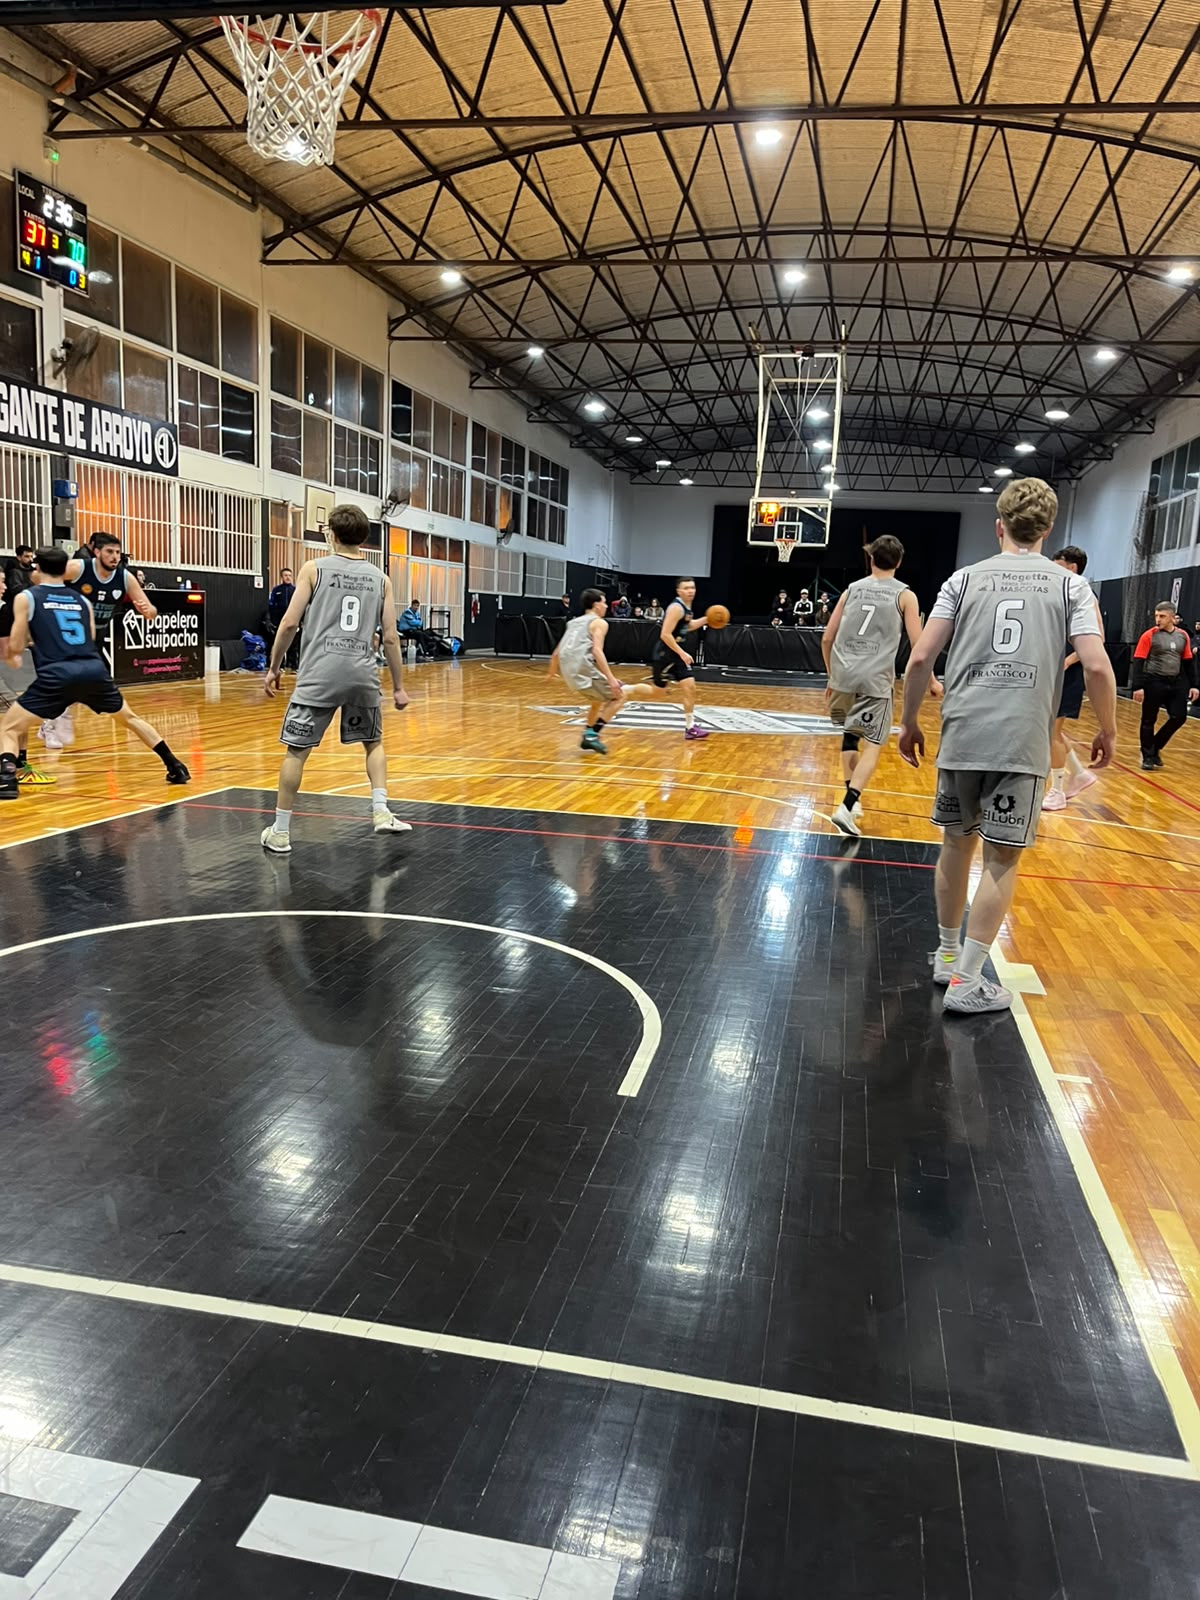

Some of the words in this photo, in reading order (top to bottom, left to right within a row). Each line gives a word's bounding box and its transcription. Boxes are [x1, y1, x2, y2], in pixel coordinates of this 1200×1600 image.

[26, 219, 46, 246] 37
[52, 233, 60, 250] 3
[68, 238, 86, 266] 70
[69, 270, 77, 285] 0
[62, 399, 87, 450] DE
[91, 407, 153, 465] ARROYO
[1000, 586, 1049, 594] MASCOTAS
[146, 610, 198, 634] papelera
[340, 595, 361, 632] 8
[858, 604, 877, 636] 7
[53, 609, 86, 645] 5
[992, 599, 1025, 655] 6
[145, 628, 198, 653] suipacha
[972, 669, 1027, 679] FRANCISCO
[983, 809, 990, 821] El
[992, 811, 1025, 826] Lubri
